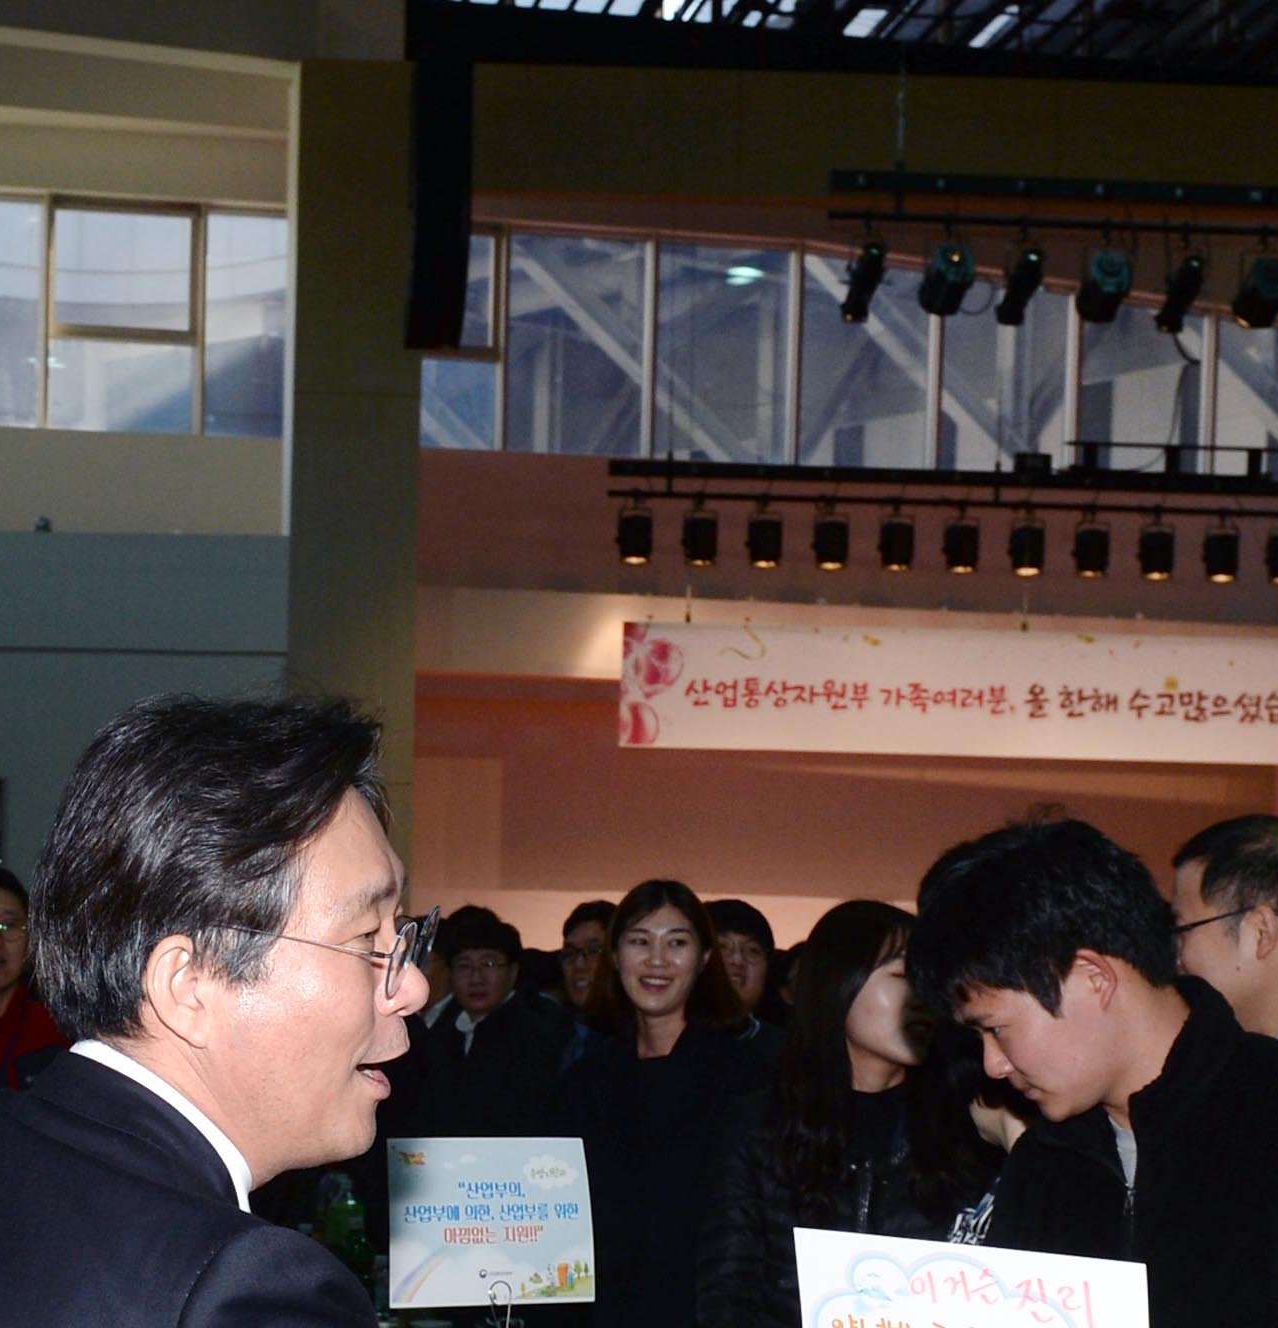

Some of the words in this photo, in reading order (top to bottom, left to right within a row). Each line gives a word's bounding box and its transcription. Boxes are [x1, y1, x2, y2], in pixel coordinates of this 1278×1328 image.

[685, 677, 871, 710] 산업통상자원부
[1024, 683, 1050, 719] 올
[1058, 686, 1118, 717] 한해
[403, 1204, 460, 1223] 산업부에
[499, 1203, 549, 1221] 산업부를
[554, 1202, 579, 1219] 위한
[444, 1226, 497, 1245] 아낌없는
[910, 1267, 1000, 1306] 이거슨
